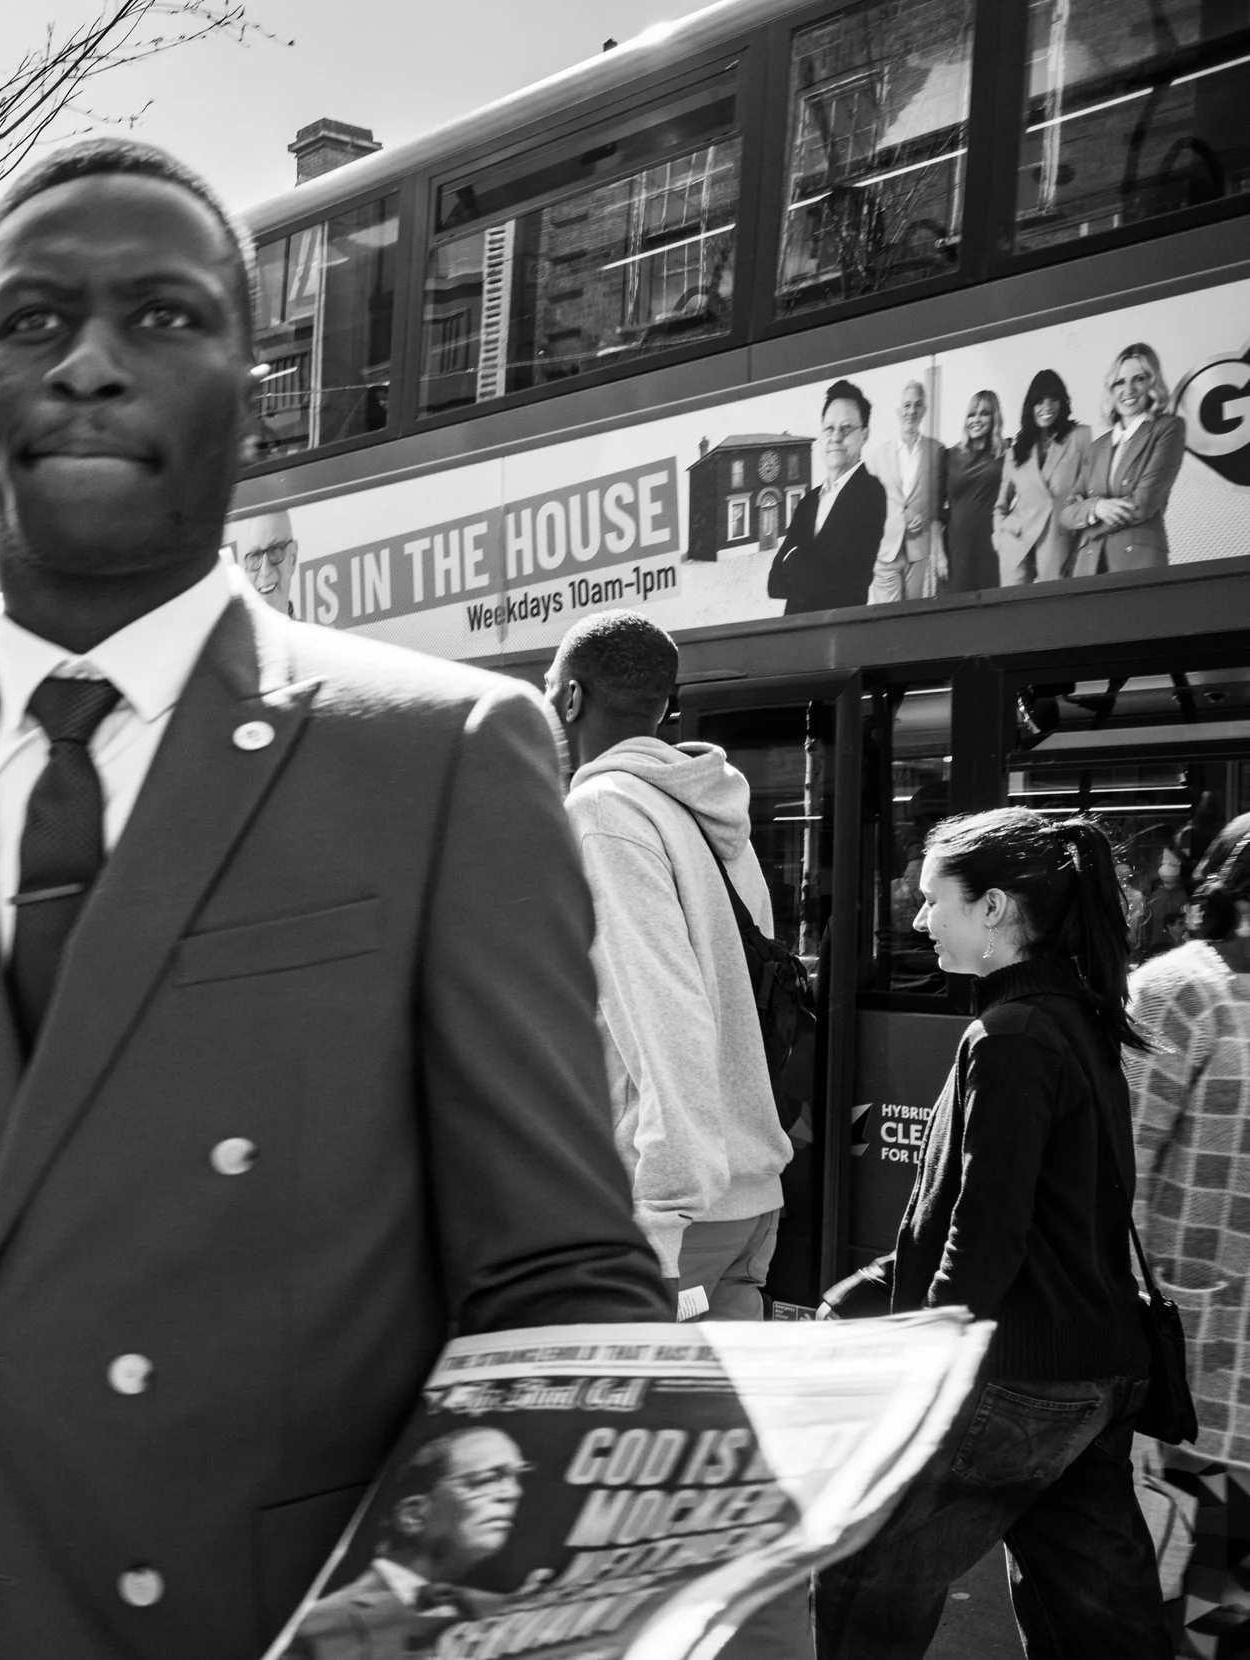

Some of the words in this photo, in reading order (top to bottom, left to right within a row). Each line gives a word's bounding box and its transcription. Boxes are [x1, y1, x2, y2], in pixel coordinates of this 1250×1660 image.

[350, 547, 392, 618] IN
[403, 520, 490, 604] THE
[505, 470, 672, 581] HOUSE
[467, 586, 565, 633] Weekdays
[881, 1104, 933, 1121] HYBRID
[880, 1121, 923, 1146] CLE
[881, 1147, 910, 1163] FOR
[564, 1427, 687, 1485] GOD
[679, 1427, 749, 1484] IS
